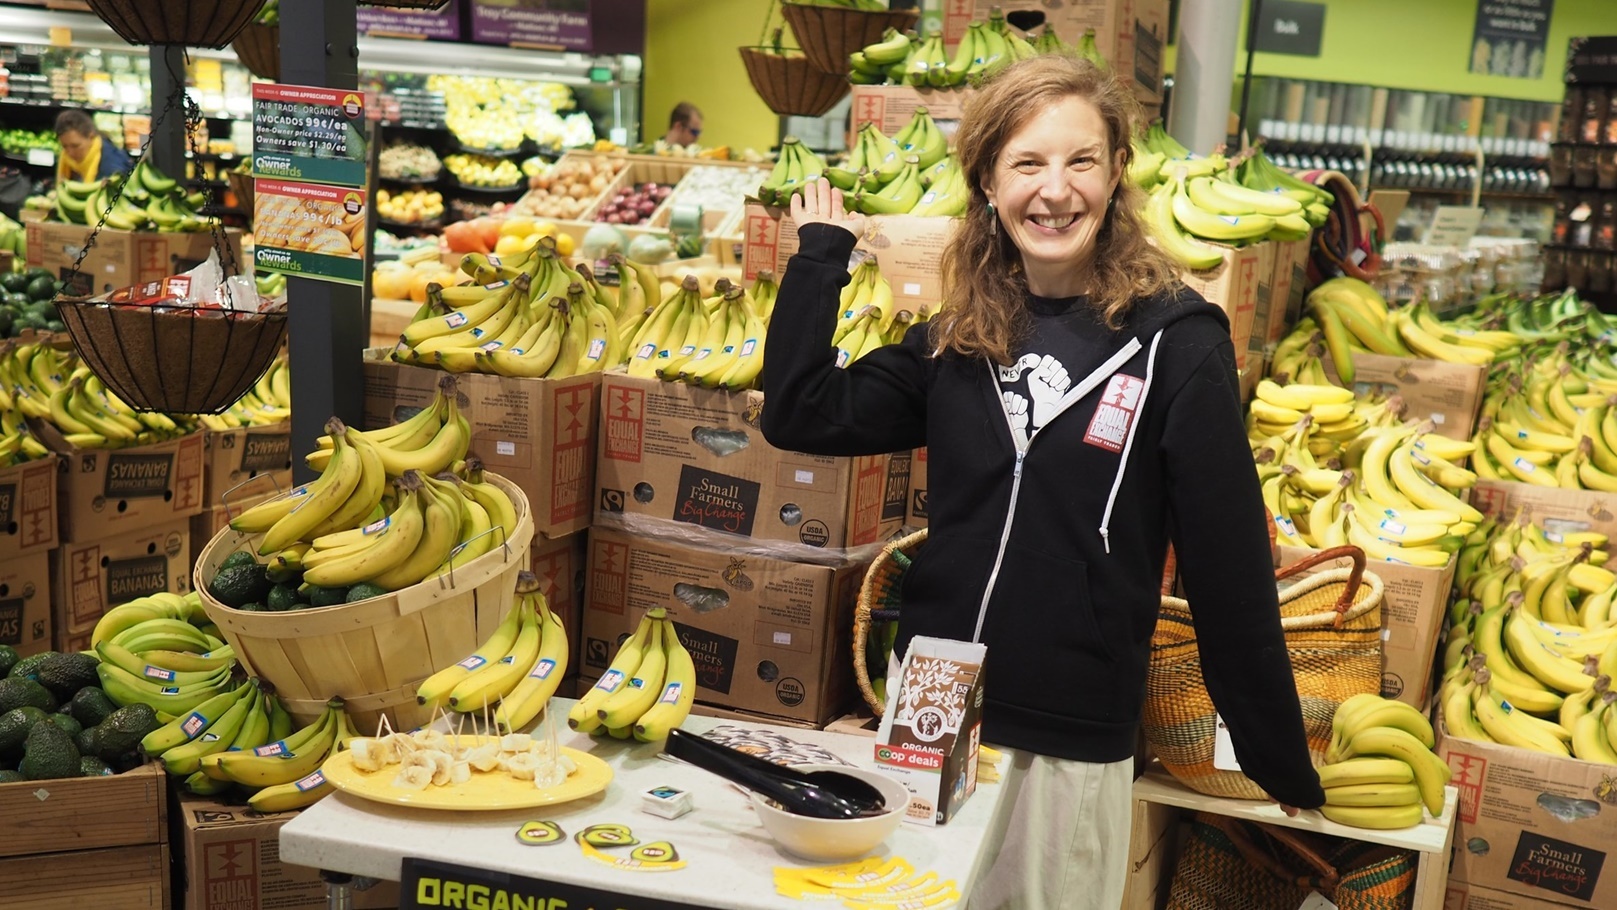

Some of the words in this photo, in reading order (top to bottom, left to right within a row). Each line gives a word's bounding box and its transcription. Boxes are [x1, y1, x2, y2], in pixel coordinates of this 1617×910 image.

[256, 102, 273, 110] FAIR
[302, 106, 339, 117] ORGANIC
[256, 114, 303, 126] AVOCADOS
[256, 126, 294, 135] Non-Owner
[256, 135, 286, 146] Owners
[288, 140, 307, 148] save
[256, 157, 290, 170] Owner
[257, 250, 291, 263] Owner
[609, 419, 638, 440] EQUAL
[608, 437, 640, 454] EXCHANGE
[112, 463, 168, 478] BANANAS
[701, 478, 739, 498] Small
[690, 486, 744, 511] Farmers
[681, 500, 702, 525] Big
[705, 500, 746, 532] Change
[807, 526, 823, 534] USDA
[112, 574, 164, 594] BANANAS
[681, 633, 718, 654] Small
[783, 683, 798, 692] USDA
[902, 742, 944, 756] ORGANIC
[908, 754, 939, 767] deals
[1540, 843, 1582, 865] Small
[1528, 850, 1586, 876] Farmers
[1515, 861, 1540, 887] Big
[1543, 865, 1587, 892] Change
[210, 880, 254, 903] EQUAL
[418, 878, 567, 910] ORGANIC
